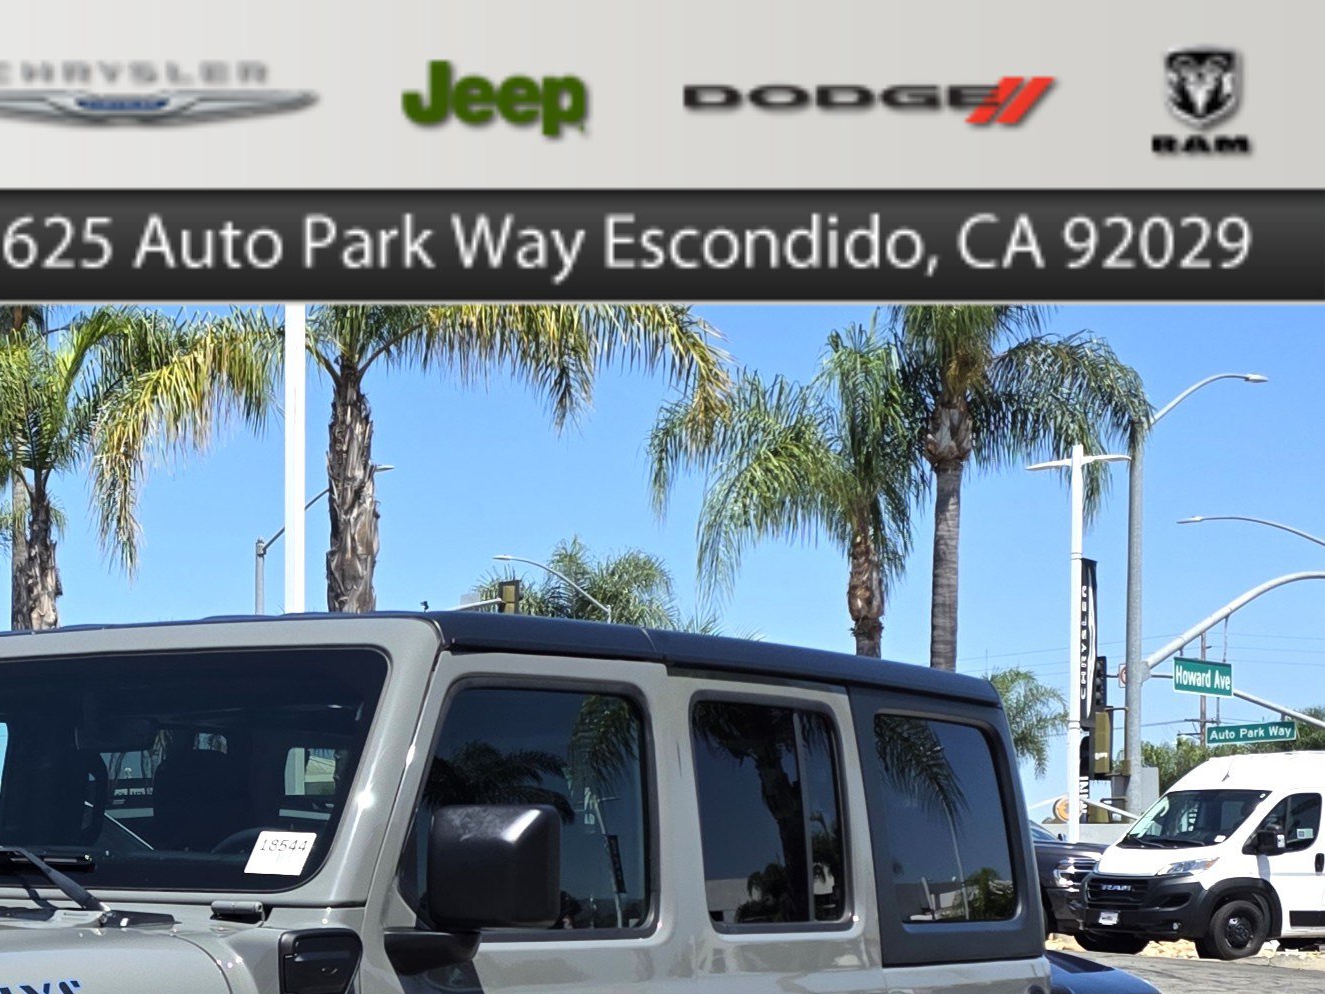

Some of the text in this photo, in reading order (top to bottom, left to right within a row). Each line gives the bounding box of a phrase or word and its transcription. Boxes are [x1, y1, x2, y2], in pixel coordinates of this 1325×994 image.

[1175, 665, 1231, 690] Howard Ave
[1210, 725, 1292, 740] Auto Park Way
